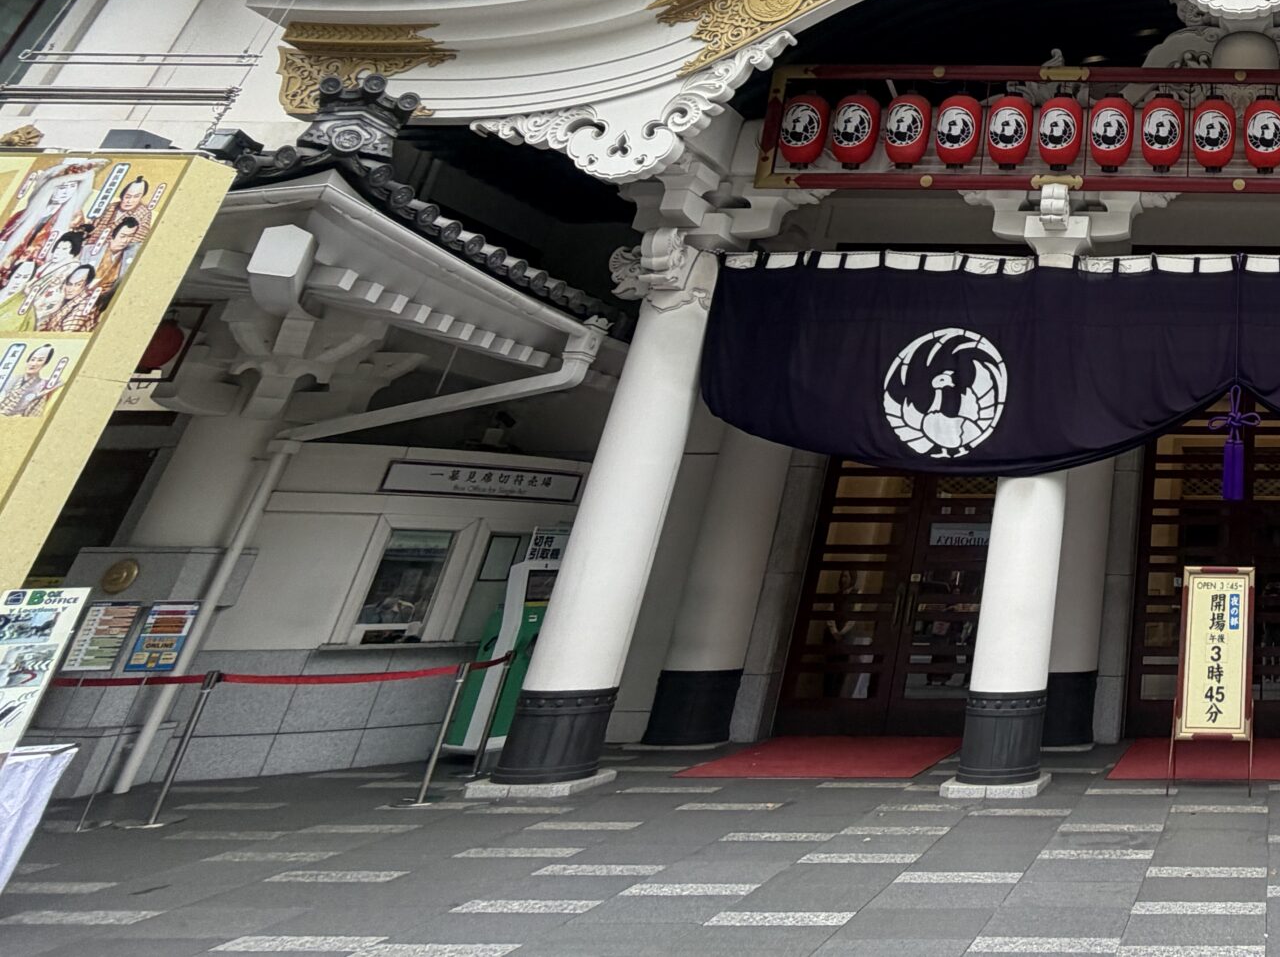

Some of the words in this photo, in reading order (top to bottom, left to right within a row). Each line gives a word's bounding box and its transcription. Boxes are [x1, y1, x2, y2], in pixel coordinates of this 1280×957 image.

[429, 469, 554, 488] 一幕見席切符売場
[1196, 581, 1217, 590] OPEN
[44, 596, 80, 605] OFFICE
[1230, 595, 1240, 627] 夜の部
